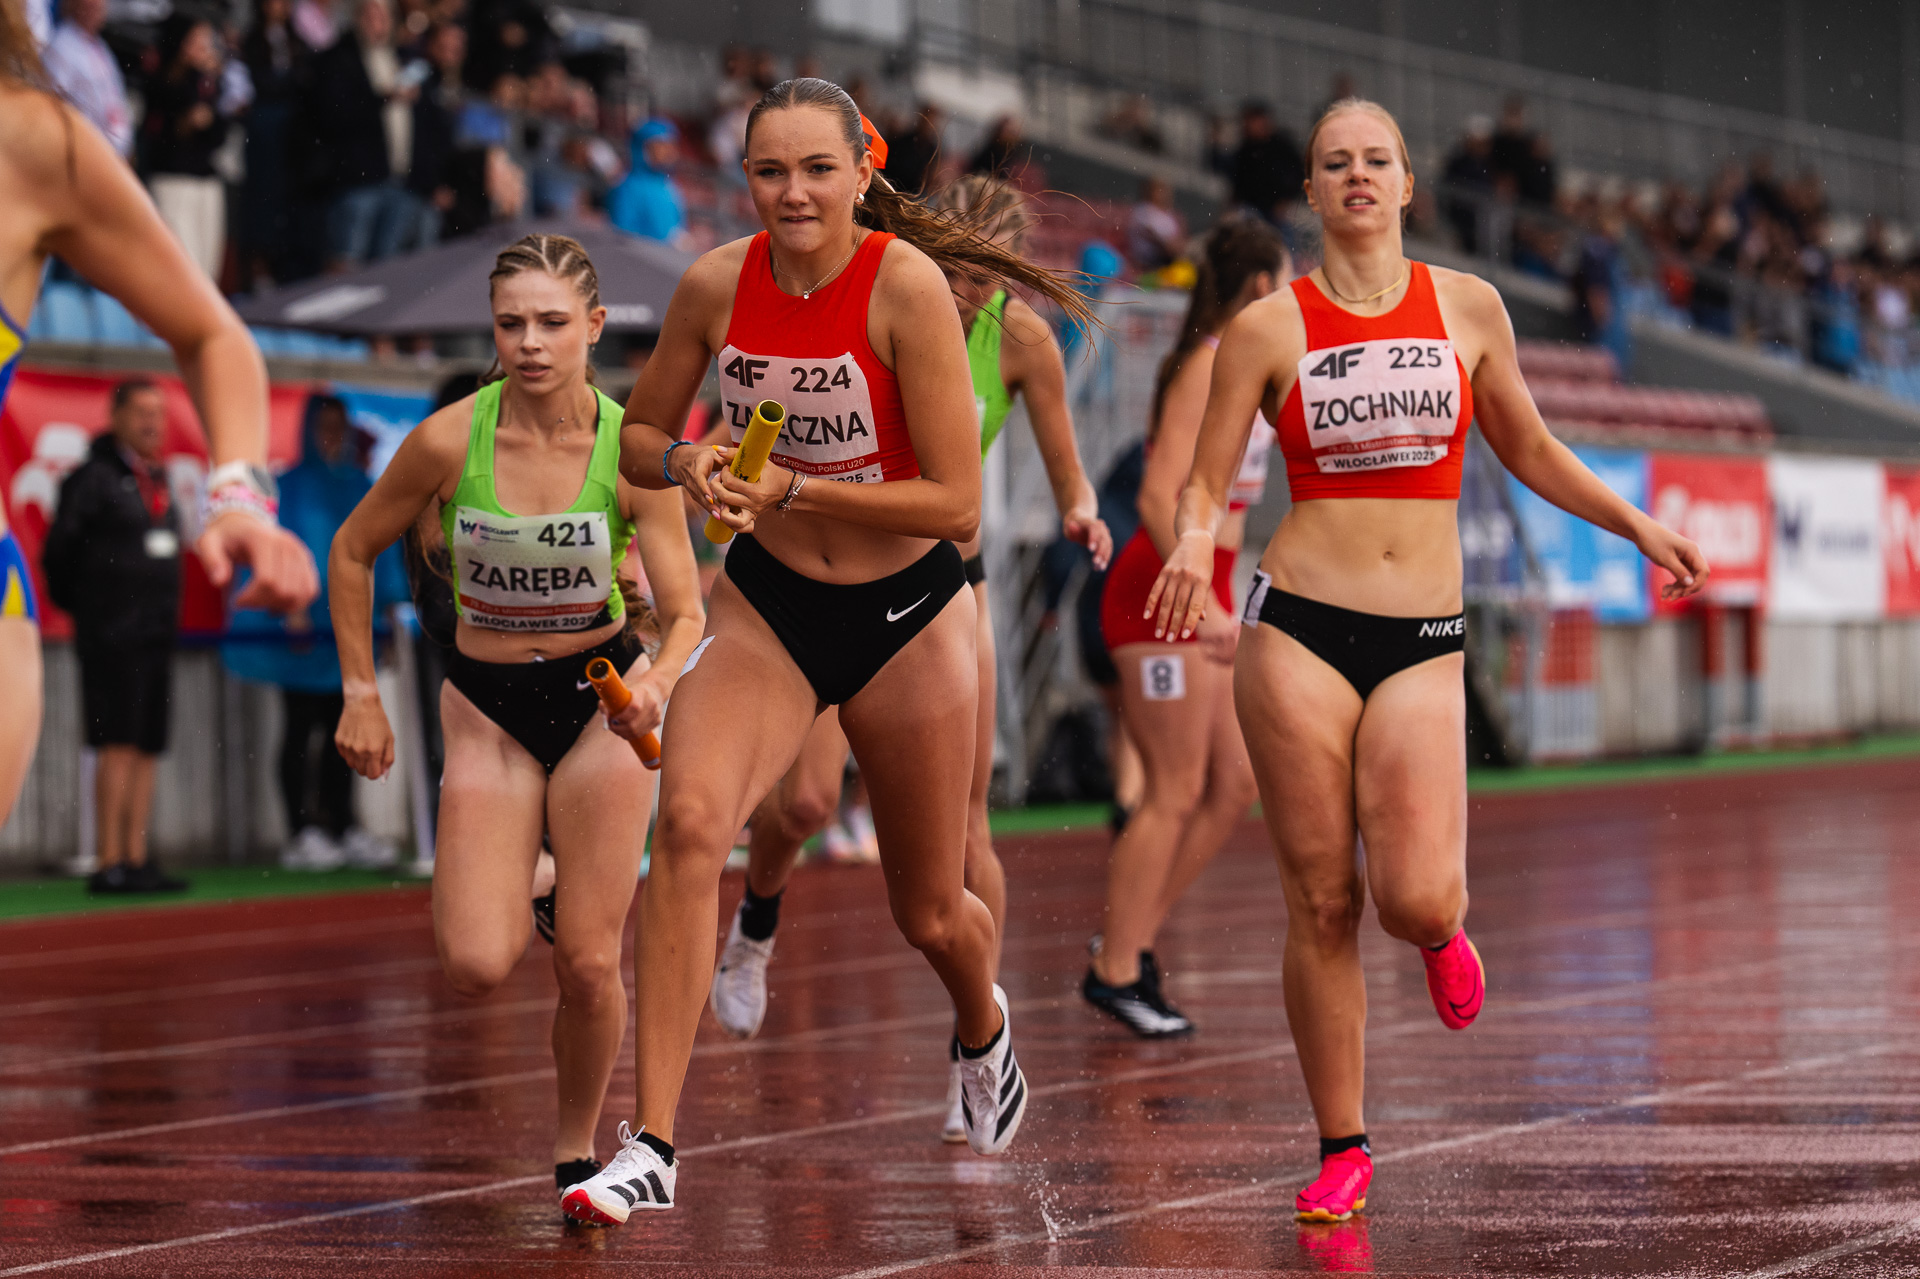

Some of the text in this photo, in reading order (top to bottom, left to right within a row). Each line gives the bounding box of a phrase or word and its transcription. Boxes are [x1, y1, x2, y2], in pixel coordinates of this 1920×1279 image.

[724, 355, 770, 389] 4F
[1309, 347, 1365, 380] 4F
[1388, 346, 1442, 370] 225
[790, 364, 852, 393] 224
[1310, 390, 1453, 431] ZOCHNIAK
[817, 463, 846, 473] Polski
[847, 458, 865, 469] U20
[537, 521, 596, 548] 421
[468, 559, 598, 597] ZARĘBA
[470, 613, 560, 628] WŁOCŁAWEK
[1418, 618, 1464, 638] NIKE
